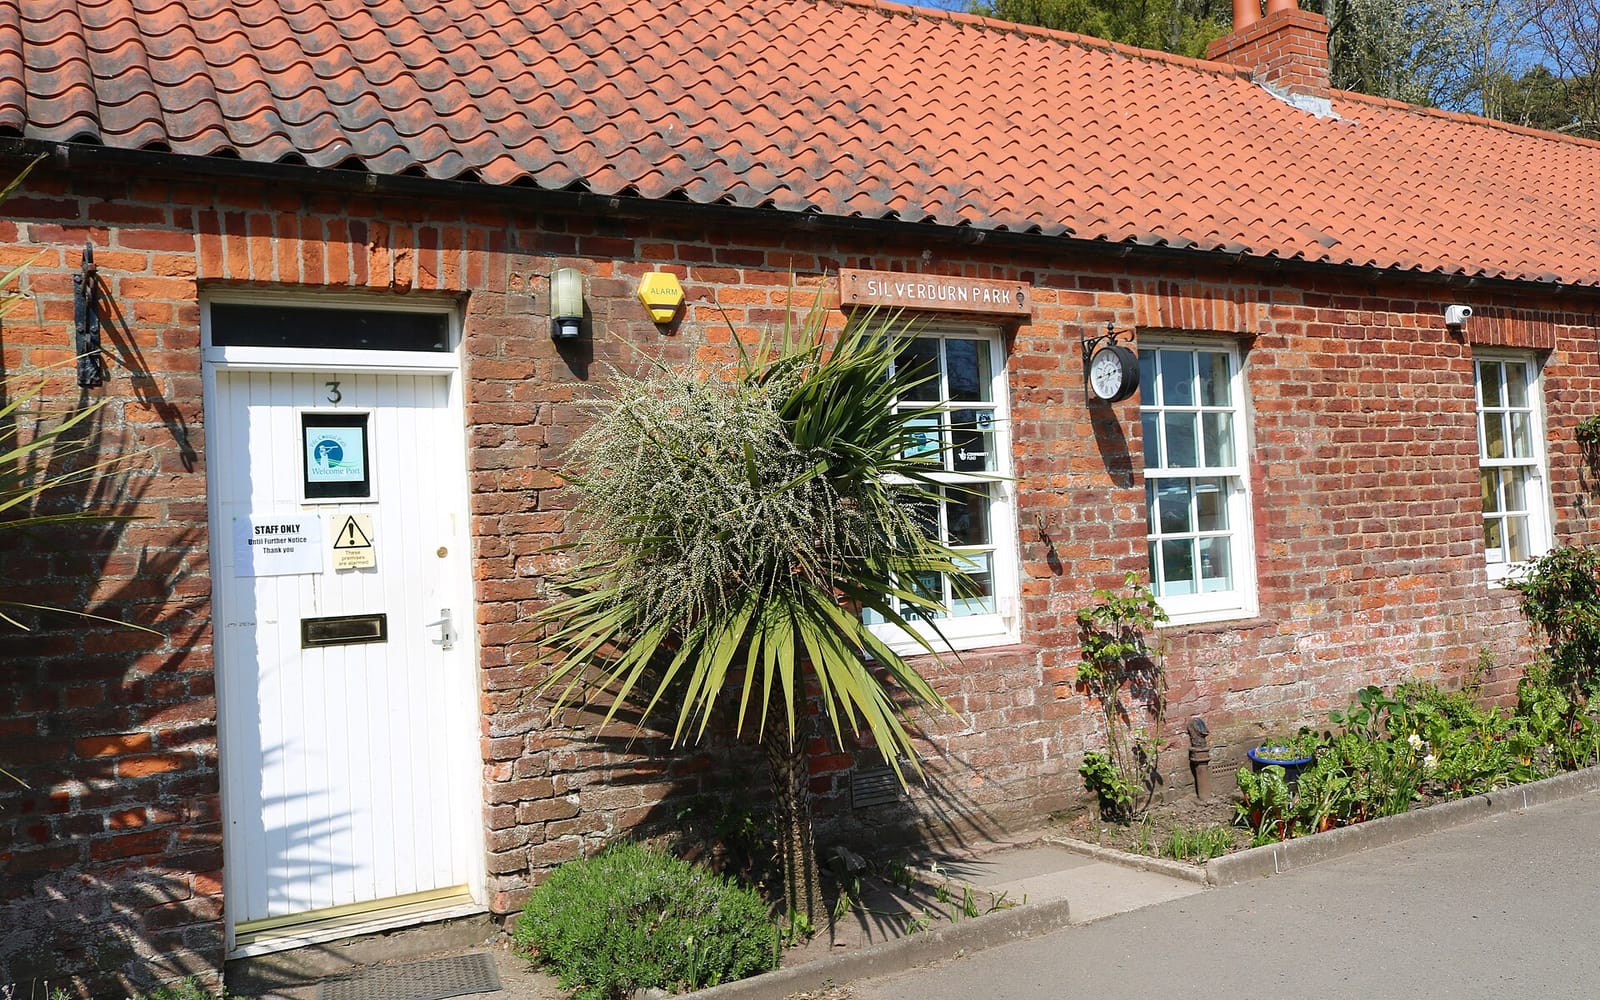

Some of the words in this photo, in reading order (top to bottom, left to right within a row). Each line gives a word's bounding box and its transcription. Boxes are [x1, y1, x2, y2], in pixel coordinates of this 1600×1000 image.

[651, 287, 678, 297] ALARM
[867, 279, 968, 302] SILVERBURN
[972, 286, 1011, 304] PARK
[326, 382, 342, 403] 3
[312, 467, 344, 475] Welcome
[346, 467, 360, 475] Port
[254, 525, 279, 535] STAFF
[281, 524, 301, 533] ONLY
[248, 538, 263, 546] Until
